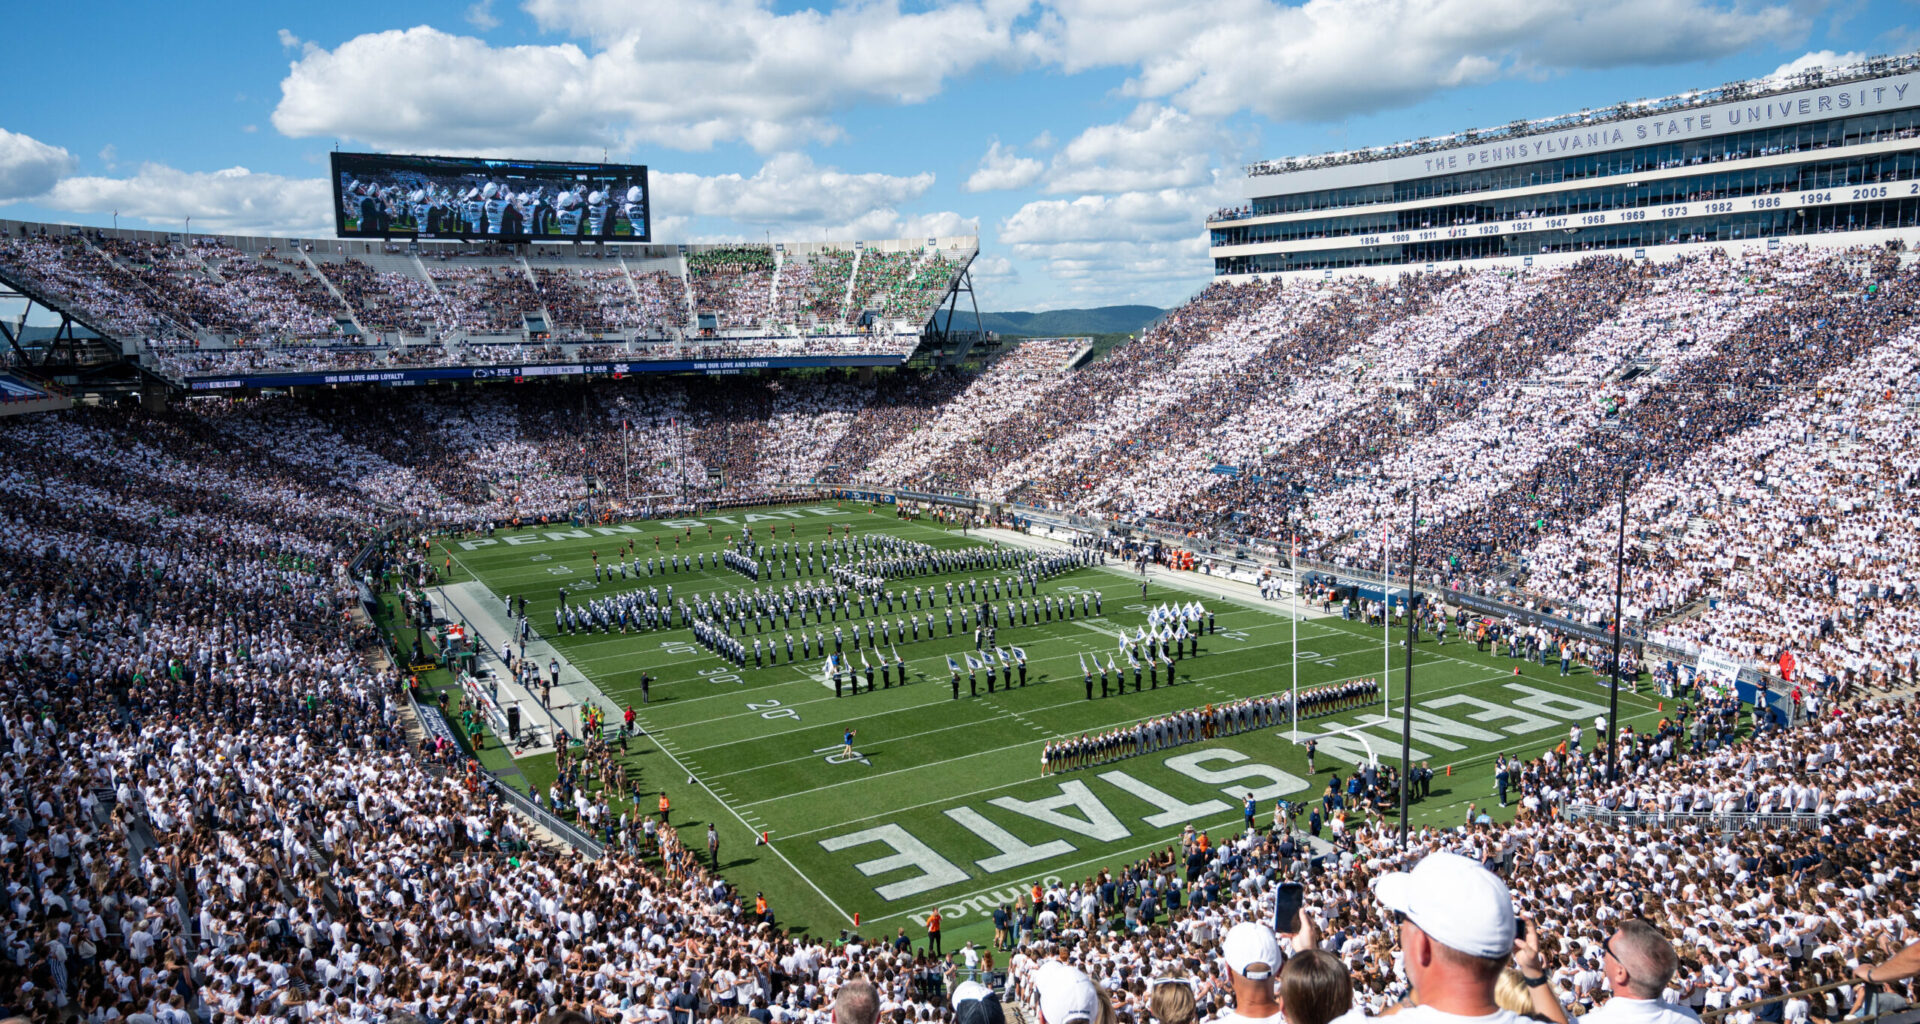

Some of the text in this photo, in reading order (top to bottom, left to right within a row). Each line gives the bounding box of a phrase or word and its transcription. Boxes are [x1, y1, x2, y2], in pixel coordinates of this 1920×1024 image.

[1424, 82, 1910, 174] THE PENNSYLVANIA STATE UNIVERSITY
[1360, 236, 1380, 246] 1894
[1391, 233, 1410, 243] 1909
[1419, 231, 1437, 240] 1911
[1479, 225, 1499, 235] 1920
[1511, 221, 1533, 231] 1921
[1545, 218, 1568, 228] 1947
[1582, 214, 1606, 225] 1968
[1620, 210, 1645, 221] 1969
[1661, 206, 1688, 217] 1973
[1704, 201, 1733, 213] 1982
[1751, 197, 1781, 209] 1986
[1800, 192, 1832, 204] 1994
[1852, 186, 1888, 200] 2005
[458, 507, 852, 551] PENN STATE
[1475, 602, 1492, 611] STATE
[1493, 606, 1522, 619] FOOTBALL
[1541, 620, 1559, 630] PENN
[1560, 624, 1580, 635] STATE
[697, 666, 740, 684] 30
[746, 699, 796, 719] 20
[813, 743, 864, 764] 10
[819, 682, 1610, 903] PENN STATE
